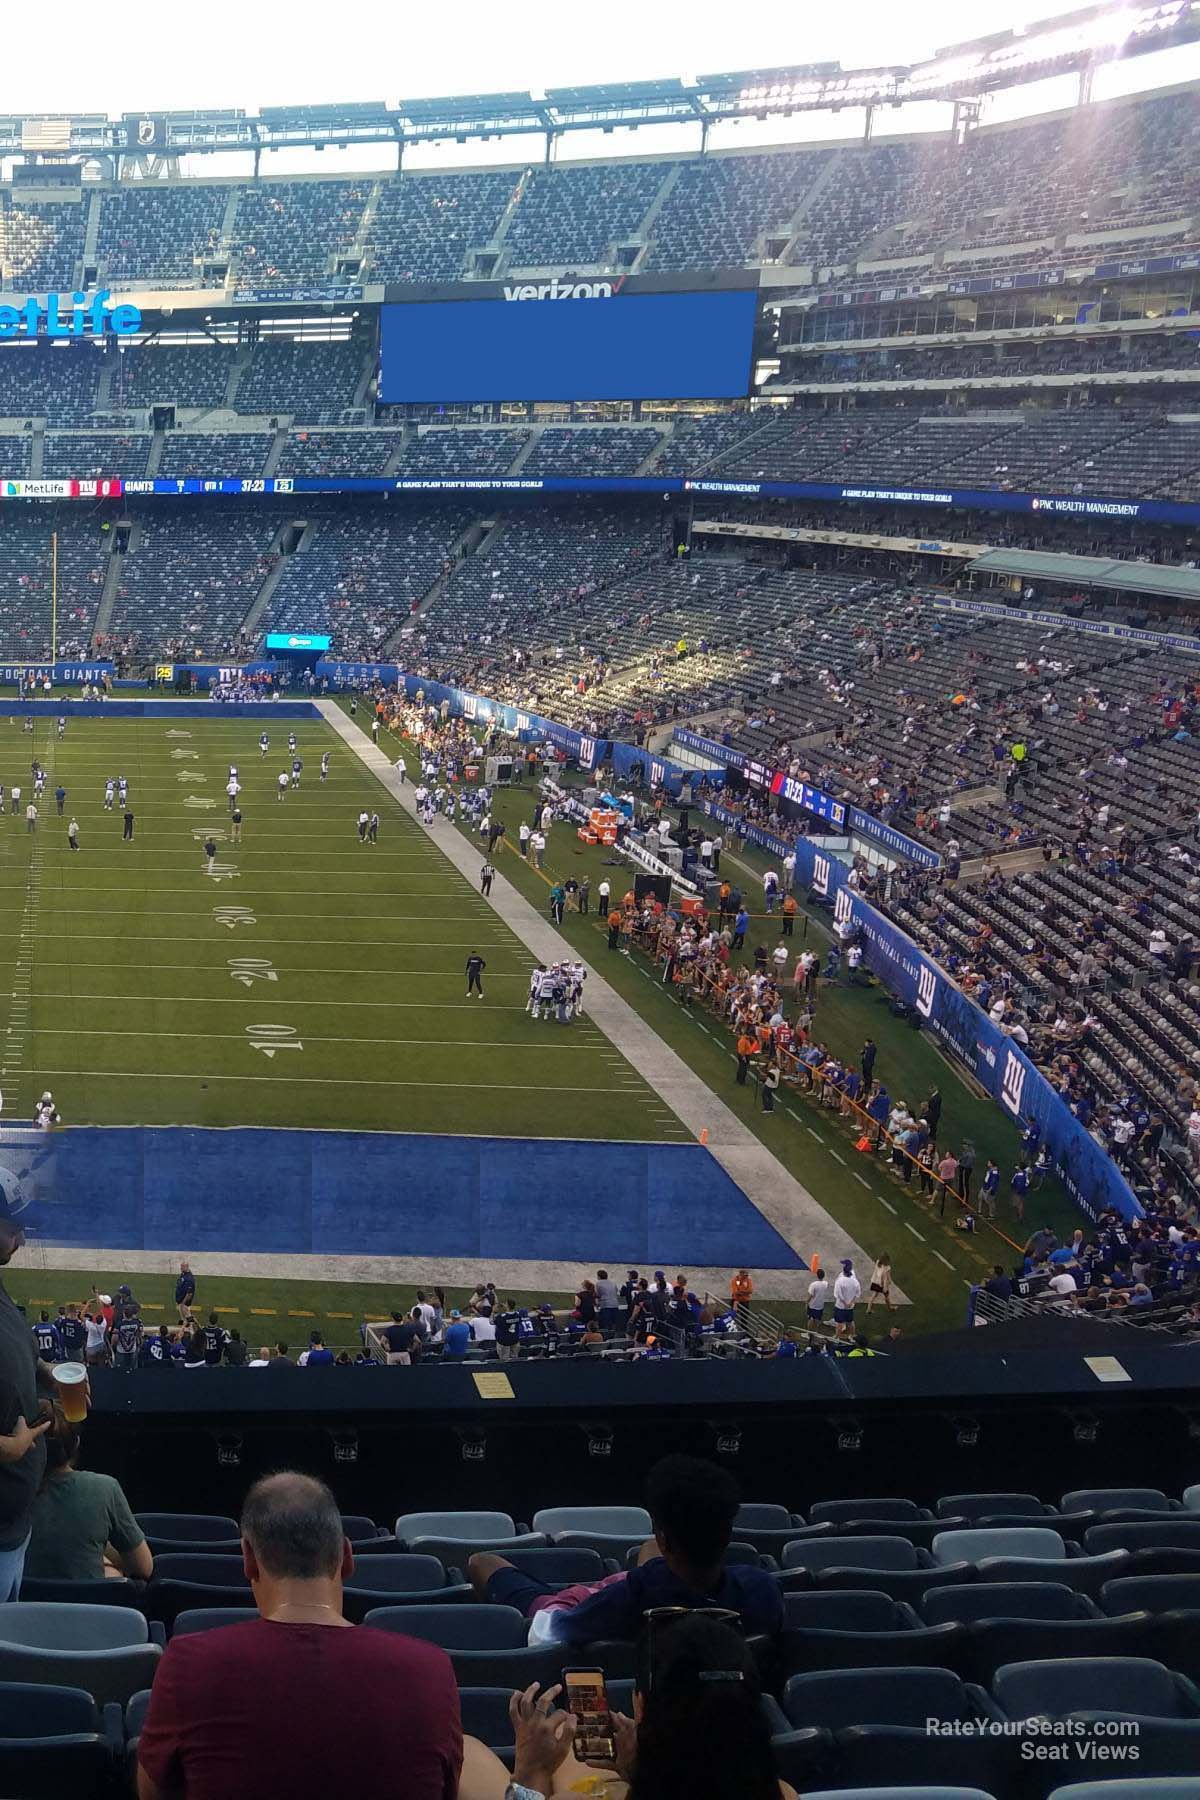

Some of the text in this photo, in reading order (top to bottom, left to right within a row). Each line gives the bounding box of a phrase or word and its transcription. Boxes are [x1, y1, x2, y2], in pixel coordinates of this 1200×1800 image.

[503, 278, 612, 301] verizon
[24, 483, 64, 493] MetLife
[102, 481, 110, 495] 0
[124, 480, 154, 491] GIANTS
[218, 481, 223, 491] 1
[279, 481, 289, 490] 25
[701, 482, 723, 491] WEALTH
[723, 483, 761, 492] MANAGEMENT
[1040, 500, 1139, 515] PNC WEALTH MANAGEMENT
[64, 669, 108, 680] GIANTS
[158, 667, 172, 678] 25
[784, 777, 804, 804] 37:23
[855, 814, 866, 827] NEW
[883, 830, 910, 855] FOOTBALL
[911, 848, 933, 868] GIANTS
[212, 906, 258, 924] 30
[877, 933, 900, 963] FOOTBALL
[902, 958, 919, 981] GIANTS
[227, 958, 279, 981] 20
[245, 1024, 304, 1051] 10
[521, 1320, 534, 1332] 13
[38, 1335, 53, 1350] 10
[206, 1338, 218, 1350] 12
